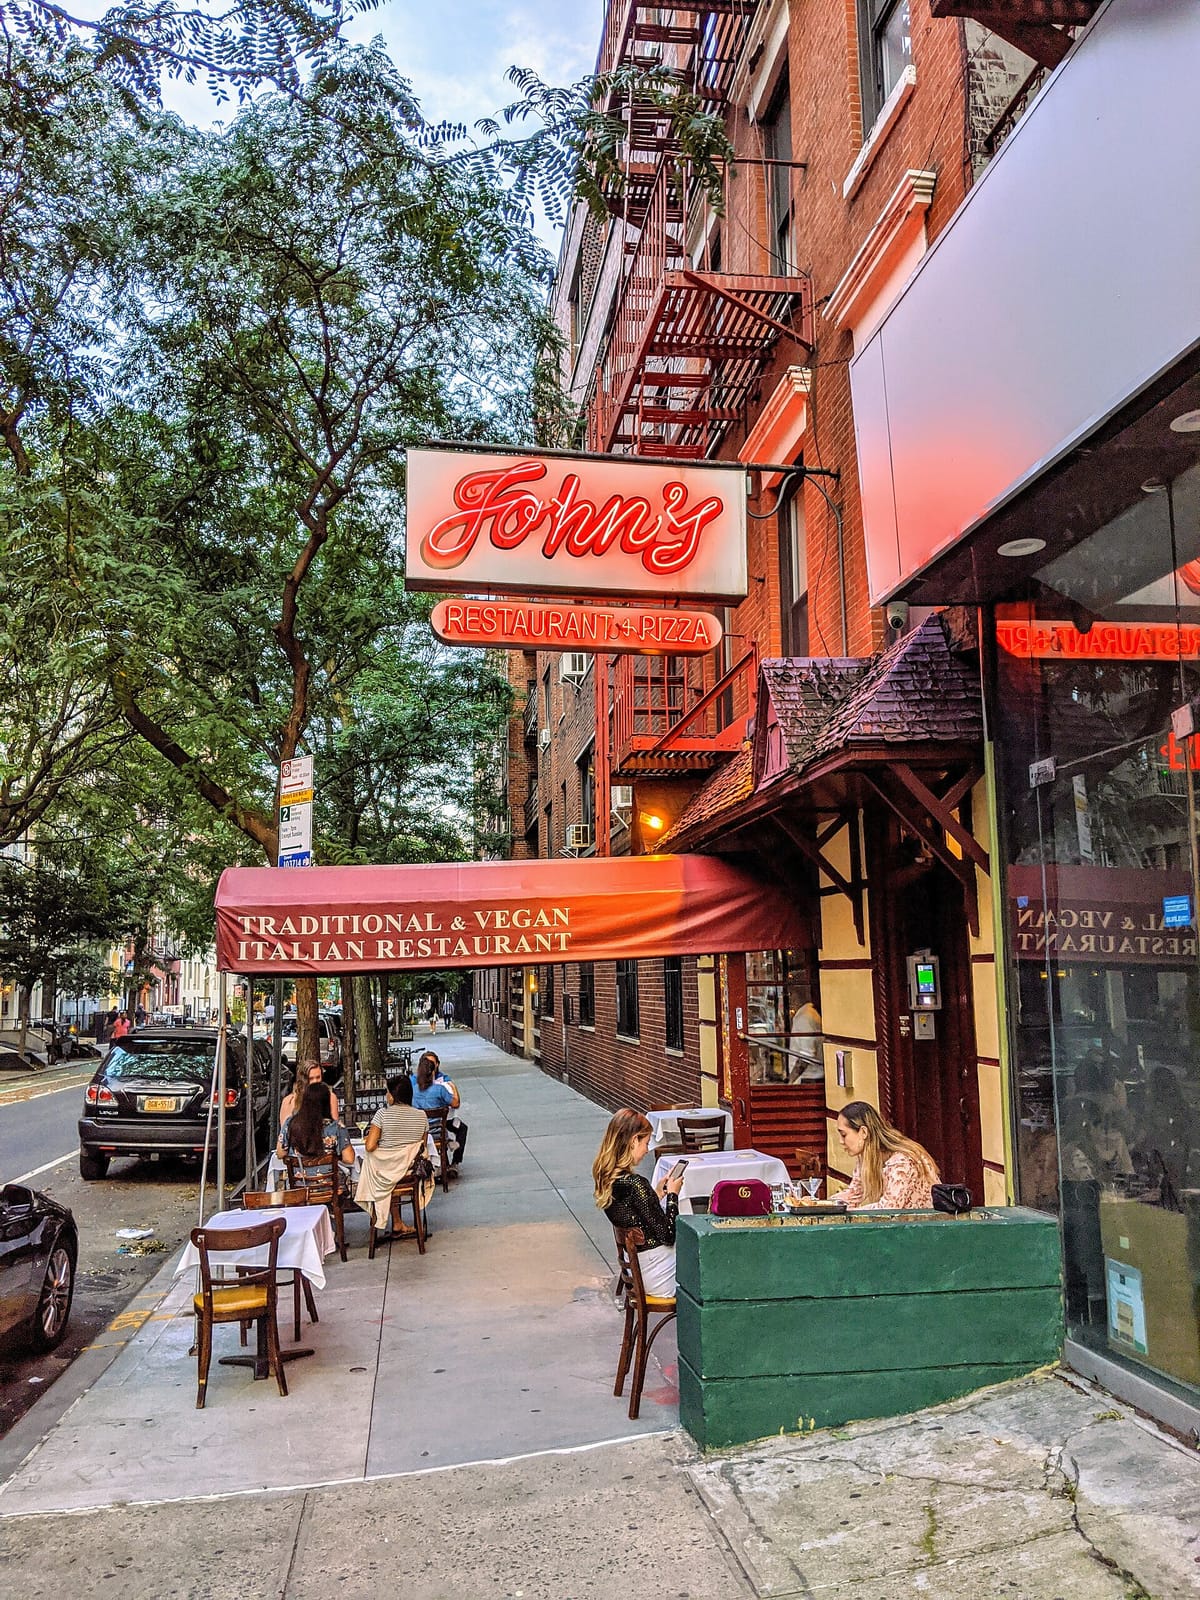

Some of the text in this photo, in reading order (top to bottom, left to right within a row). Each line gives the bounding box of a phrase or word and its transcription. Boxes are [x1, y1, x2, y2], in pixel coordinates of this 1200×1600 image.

[420, 462, 723, 575] John's
[444, 604, 613, 641] RESTAURANT
[638, 615, 711, 645] PIZZA
[238, 907, 572, 936] TRADITIONAL & VEGAN
[238, 932, 573, 962] ITALIAN RESTAURANT
